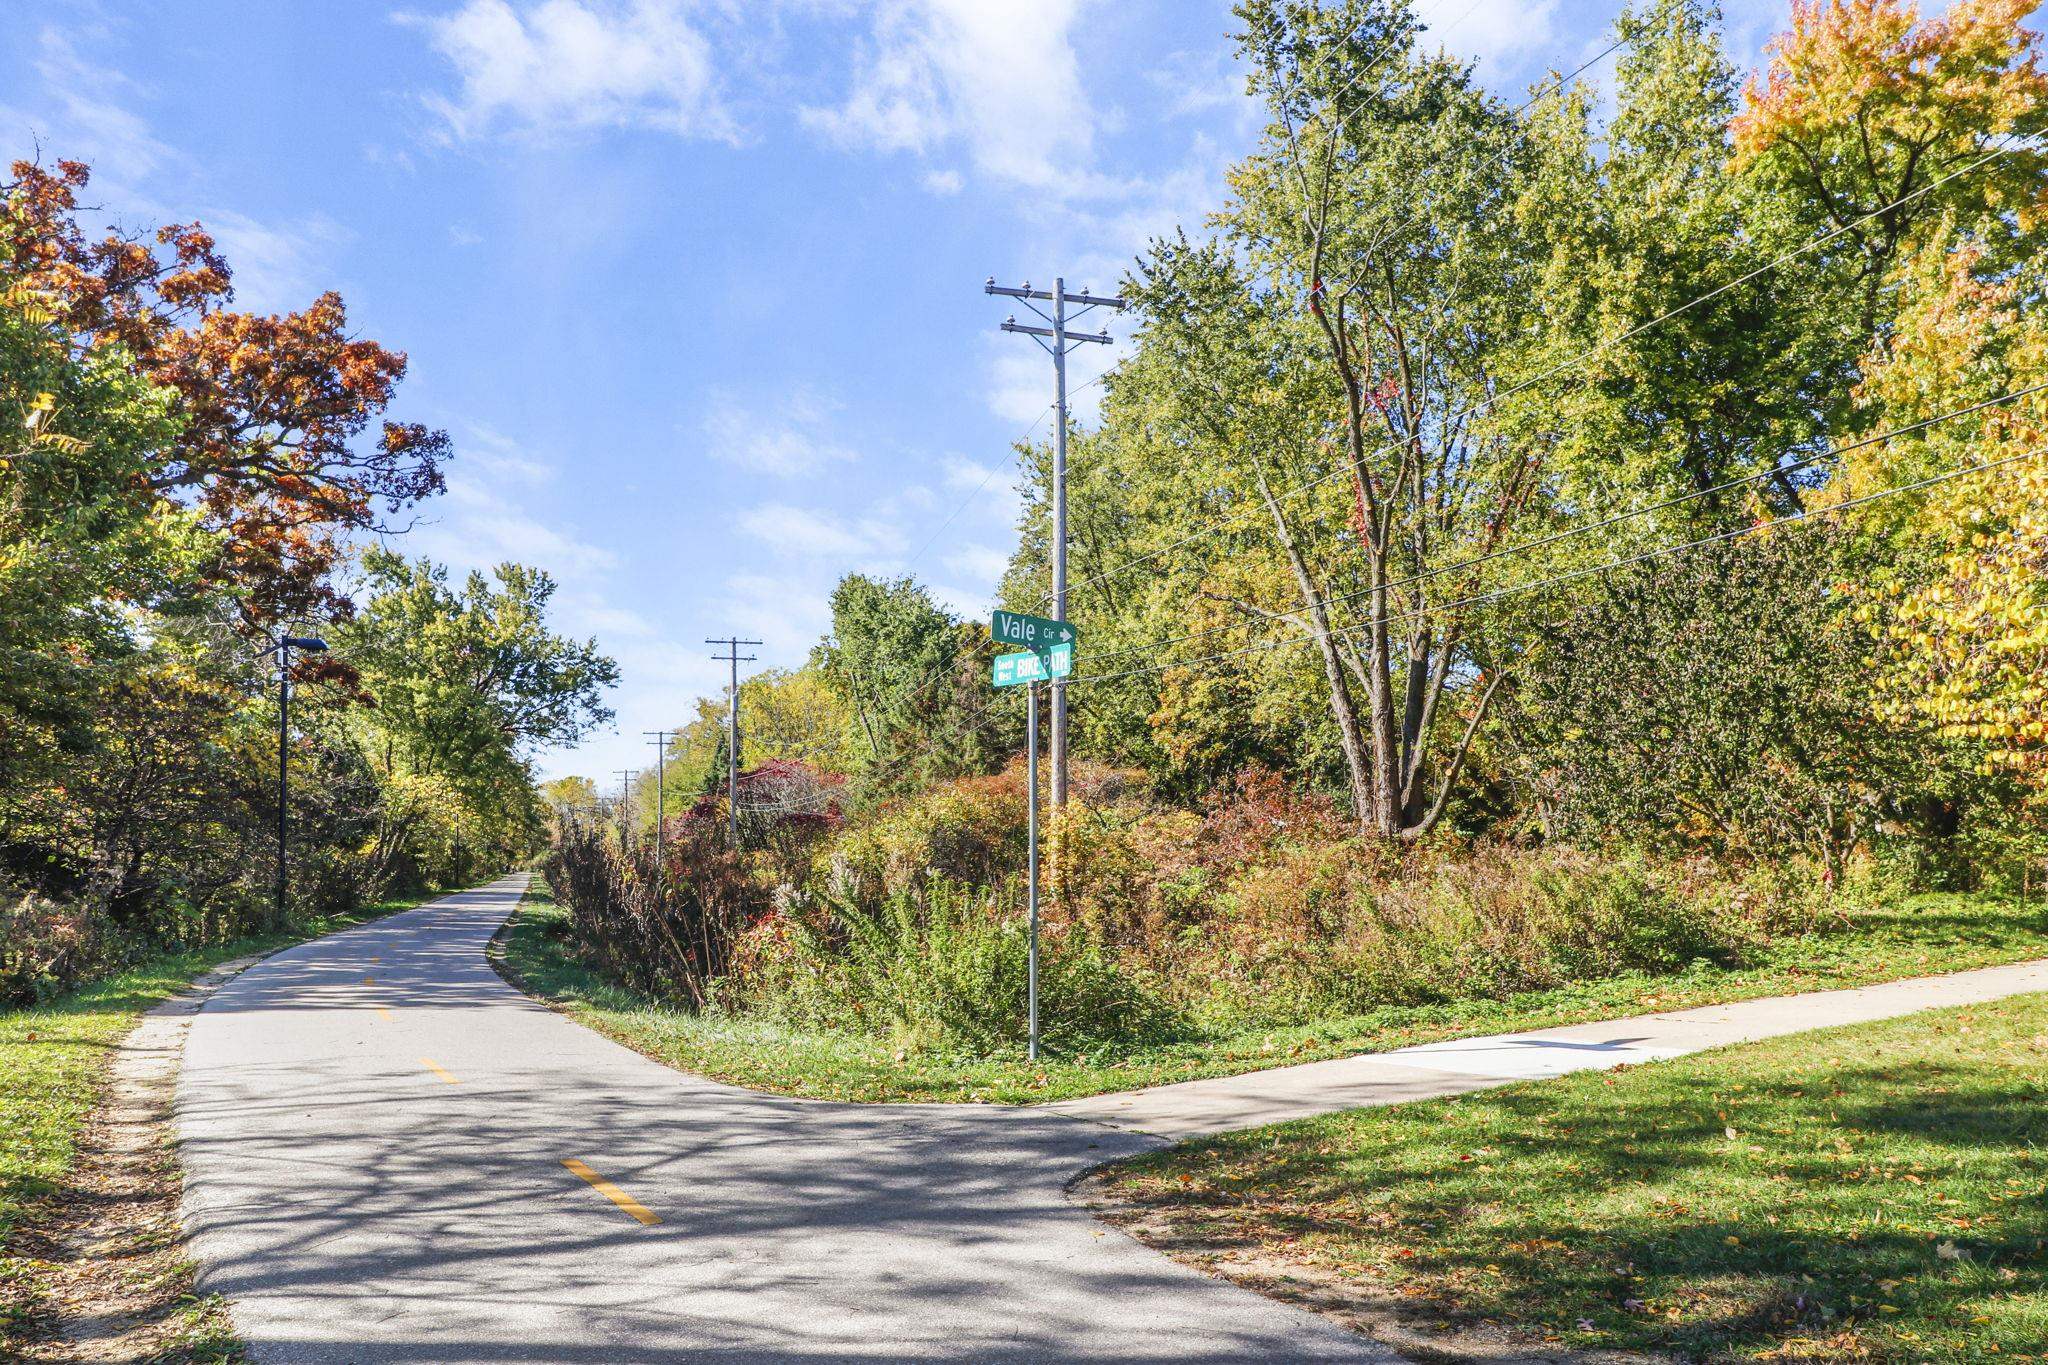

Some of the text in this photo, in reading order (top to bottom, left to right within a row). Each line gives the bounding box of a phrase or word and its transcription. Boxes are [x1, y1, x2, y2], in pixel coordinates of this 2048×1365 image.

[1001, 614, 1055, 641] Vale Cir
[1016, 650, 1068, 678] BIKE PATH
